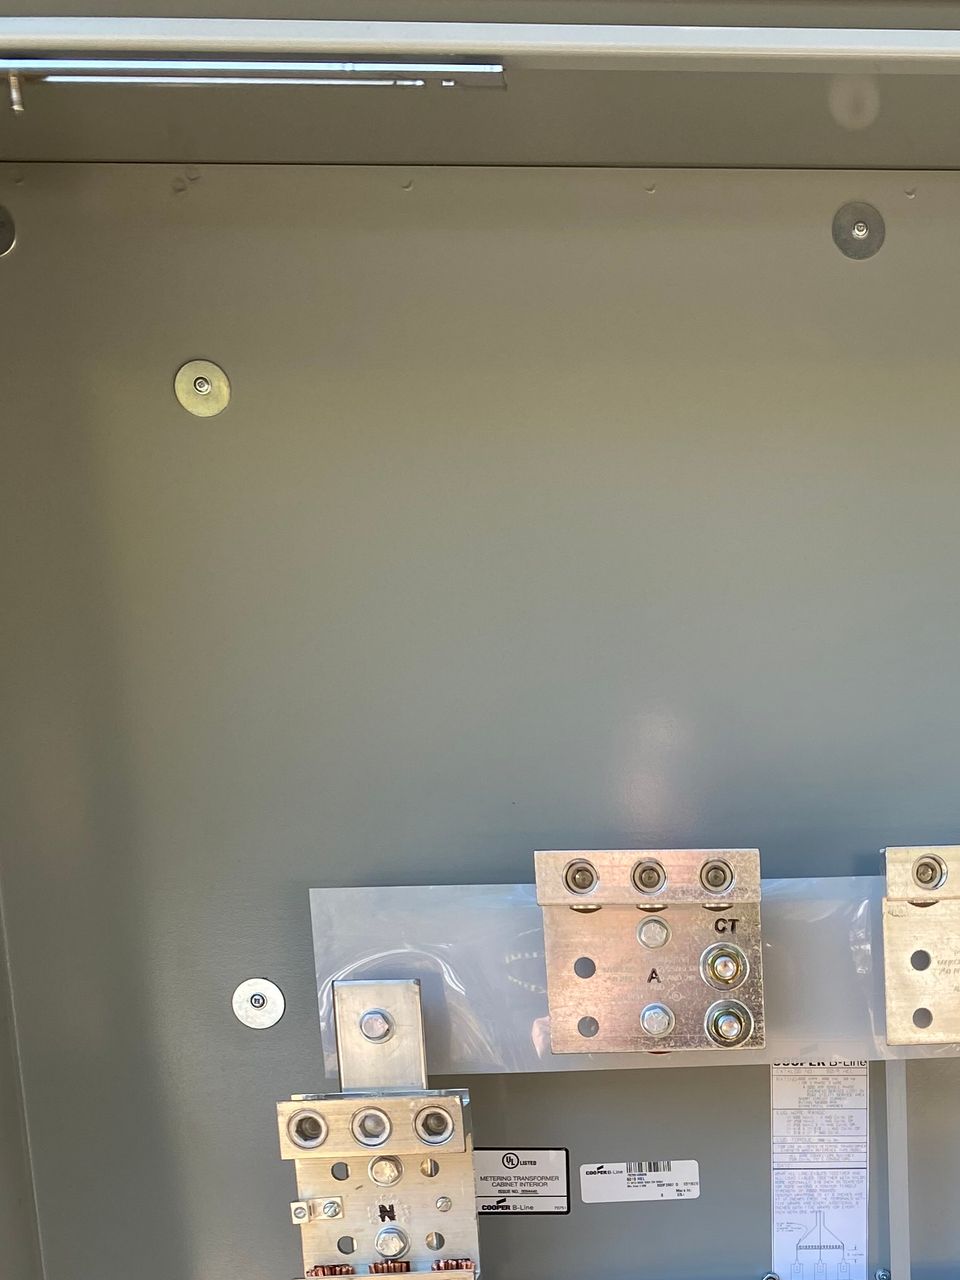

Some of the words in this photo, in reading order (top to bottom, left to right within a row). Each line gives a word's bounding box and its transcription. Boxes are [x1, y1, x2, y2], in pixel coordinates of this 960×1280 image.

[715, 918, 739, 934] CT
[647, 968, 661, 983] A
[378, 1204, 397, 1222] N
